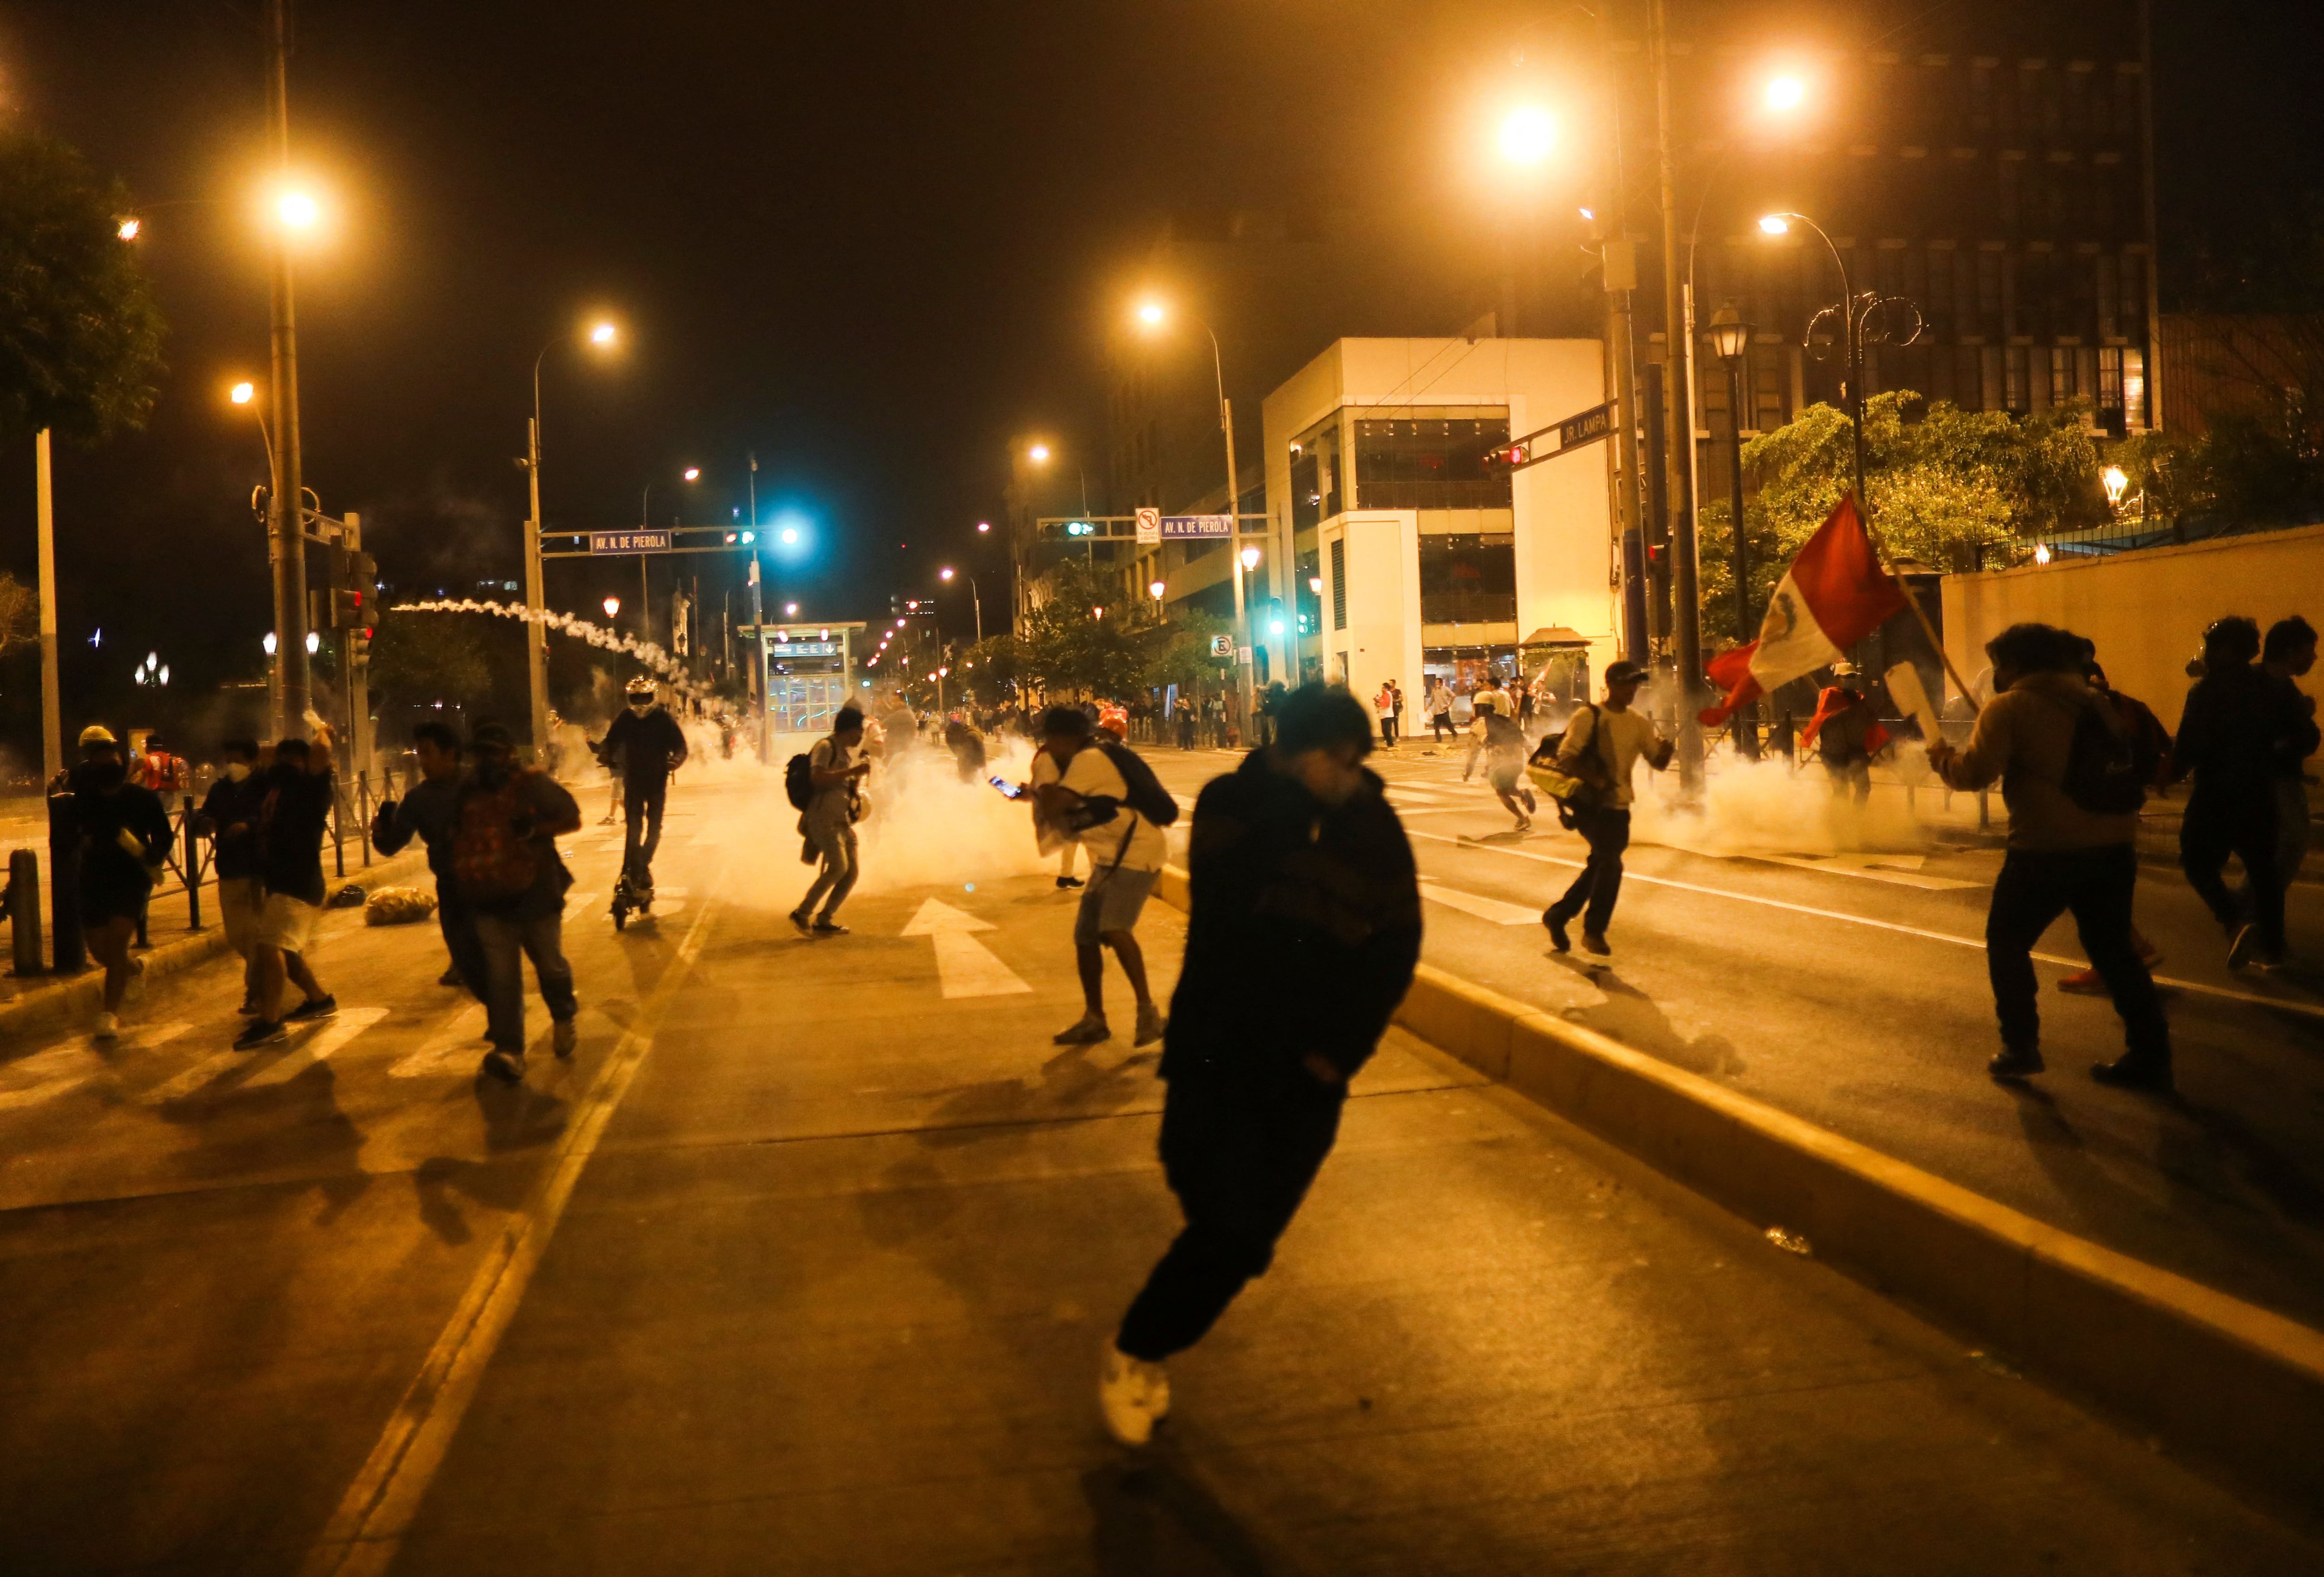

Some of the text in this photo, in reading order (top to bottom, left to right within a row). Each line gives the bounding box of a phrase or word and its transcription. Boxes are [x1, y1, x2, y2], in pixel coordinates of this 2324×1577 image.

[1565, 413, 1607, 444] JR. LAMPA
[1165, 521, 1228, 533] AV. N. DE PIEROLA
[596, 536, 666, 550] AV. N. DE PIEROLA
